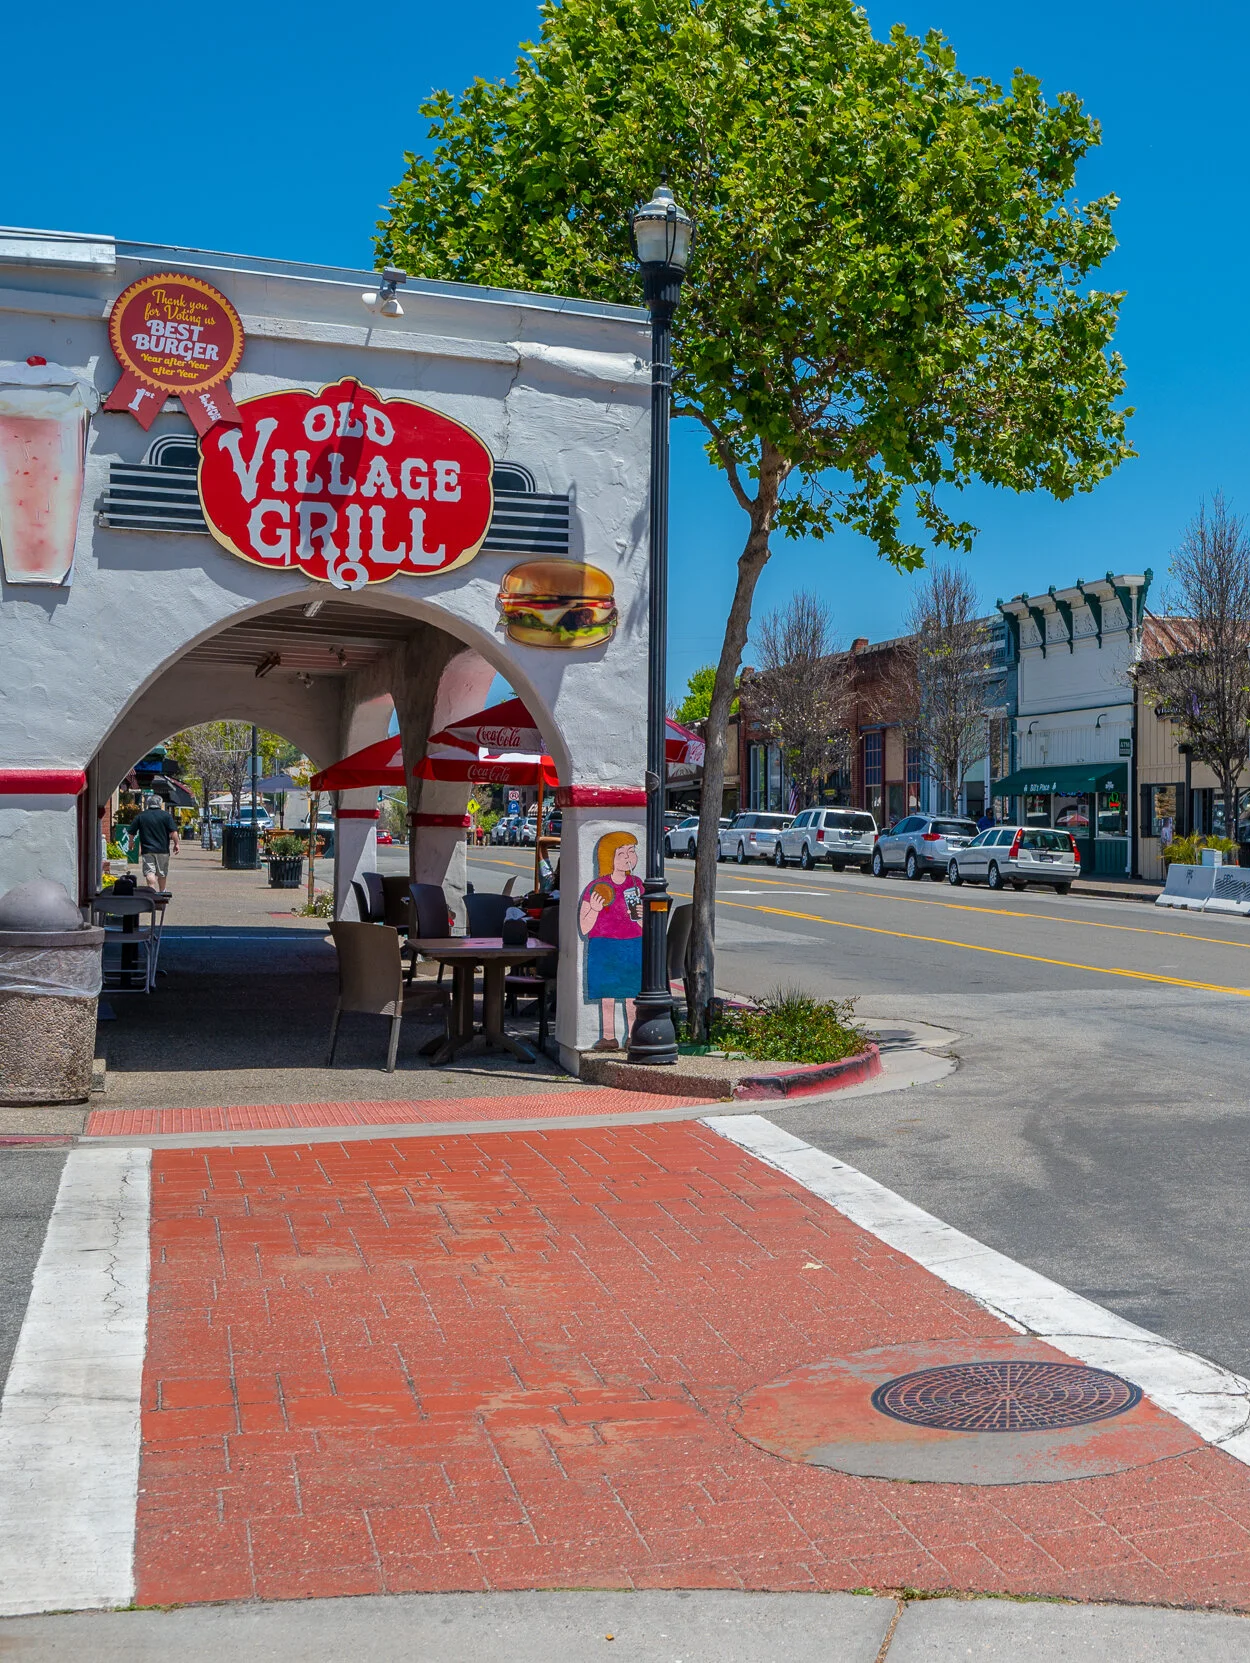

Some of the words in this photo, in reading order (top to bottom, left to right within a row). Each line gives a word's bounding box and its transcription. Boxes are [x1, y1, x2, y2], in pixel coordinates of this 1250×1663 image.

[152, 289, 187, 307] Thank
[189, 301, 208, 314] you
[144, 302, 160, 321] for
[164, 305, 201, 327] Voting
[204, 316, 216, 326] us
[146, 319, 204, 342] BEST
[131, 333, 219, 361] BURGER
[141, 353, 162, 362] Year
[164, 357, 187, 368] after
[188, 360, 210, 371] Year
[152, 367, 175, 376] after
[177, 369, 199, 379] Year
[127, 388, 155, 412] 1st
[302, 402, 395, 446] OLD
[218, 417, 462, 503] VILLAGE
[247, 498, 446, 591] GRILL
